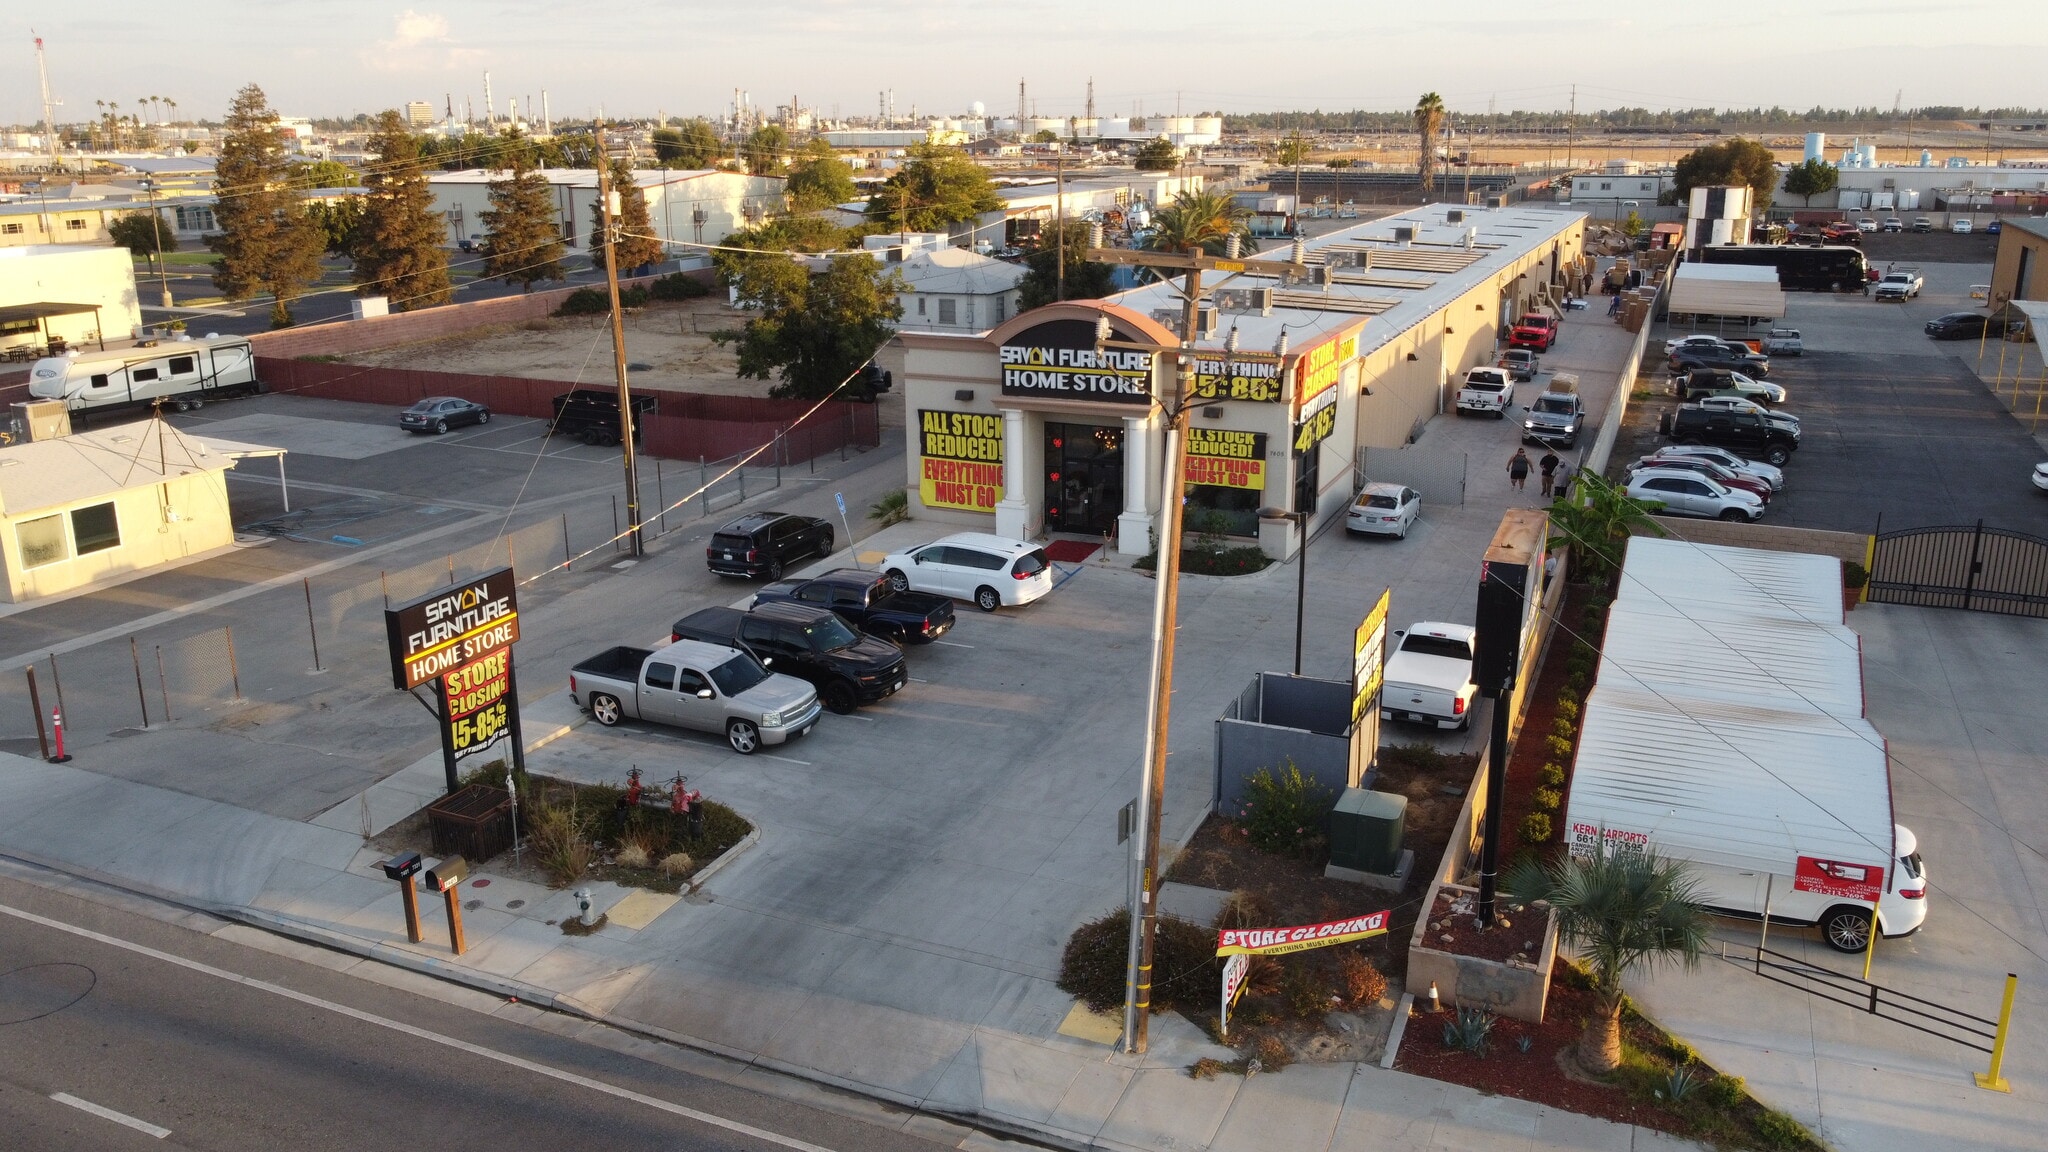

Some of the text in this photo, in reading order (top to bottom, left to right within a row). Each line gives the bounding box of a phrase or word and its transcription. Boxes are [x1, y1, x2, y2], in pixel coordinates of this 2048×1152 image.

[1000, 346, 1152, 371] SAVON FURNITURE
[1310, 339, 1336, 374] STORE
[1005, 370, 1146, 395] HOME STORE
[1303, 360, 1338, 401] CLOSING
[924, 412, 1003, 438] ALL STOCK
[1188, 428, 1256, 445] LL STOCK
[926, 433, 1003, 461] REDUCED!
[1185, 469, 1248, 486] MUST GO
[1186, 456, 1260, 474] VERYTHING
[935, 481, 995, 508] MUST GO
[425, 583, 488, 624] SAVON
[409, 596, 510, 654] FURNITURE
[413, 622, 513, 681] HOME STORE
[448, 651, 506, 696] STORE
[450, 677, 506, 716] CLOSING
[1572, 822, 1598, 836] KERN
[1576, 833, 1643, 853] 661-13-7695
[1808, 887, 1865, 900] 661-213-7695
[1222, 914, 1383, 949] STORE CLOSING
[1263, 937, 1342, 955] EVERYTHING MUST GO!
